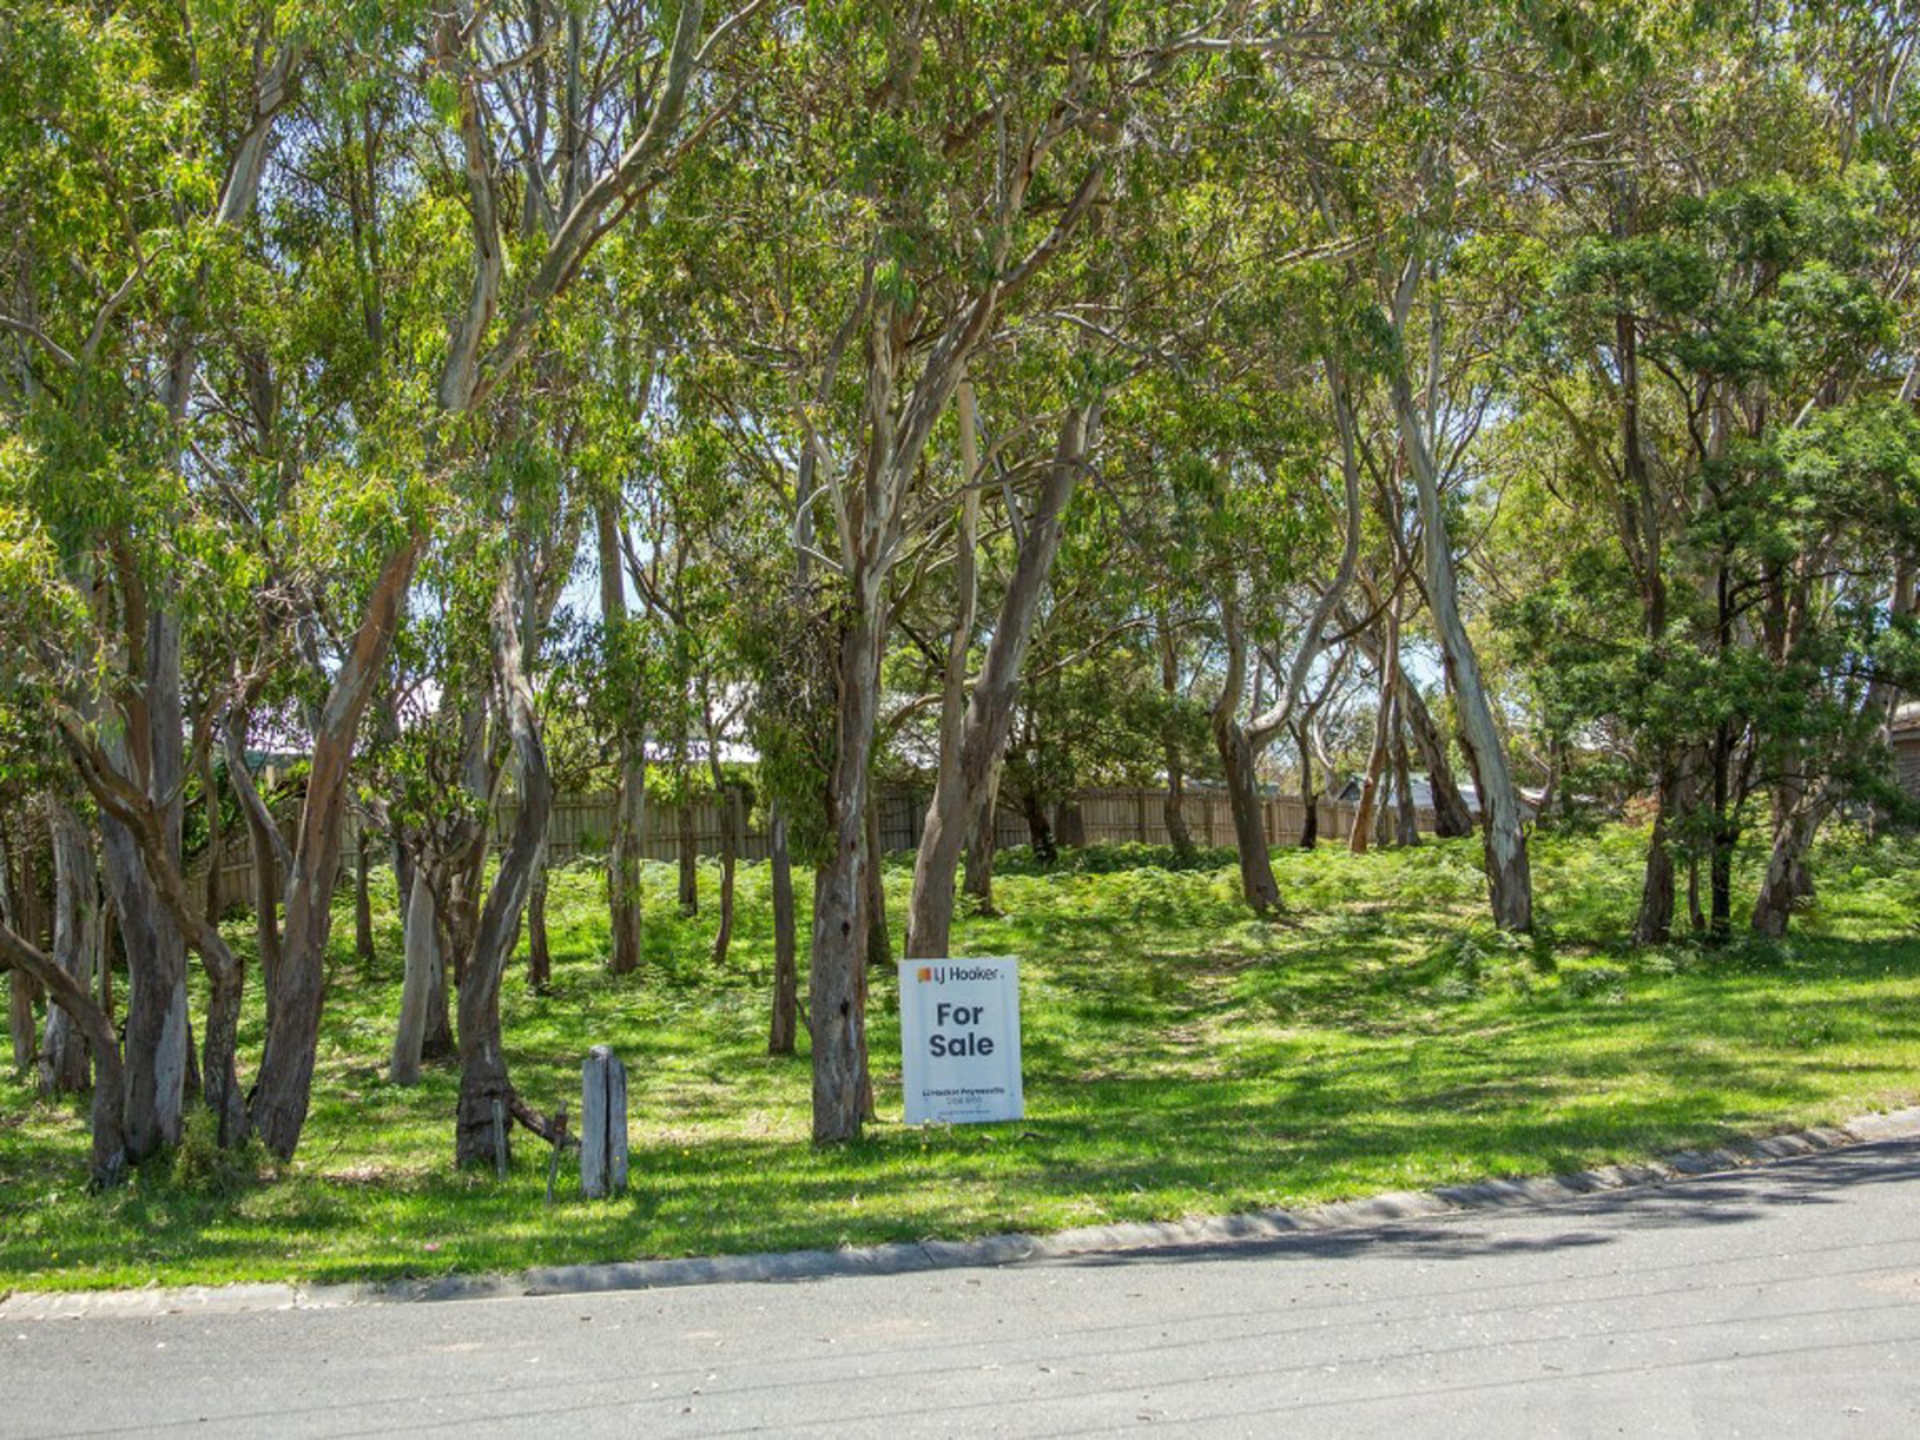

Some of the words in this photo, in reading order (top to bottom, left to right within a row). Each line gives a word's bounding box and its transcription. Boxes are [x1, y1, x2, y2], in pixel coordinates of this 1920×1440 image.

[934, 967, 945, 984] LJ
[949, 967, 998, 980] Hooker
[937, 1003, 984, 1026] For
[929, 1032, 994, 1057] Sale
